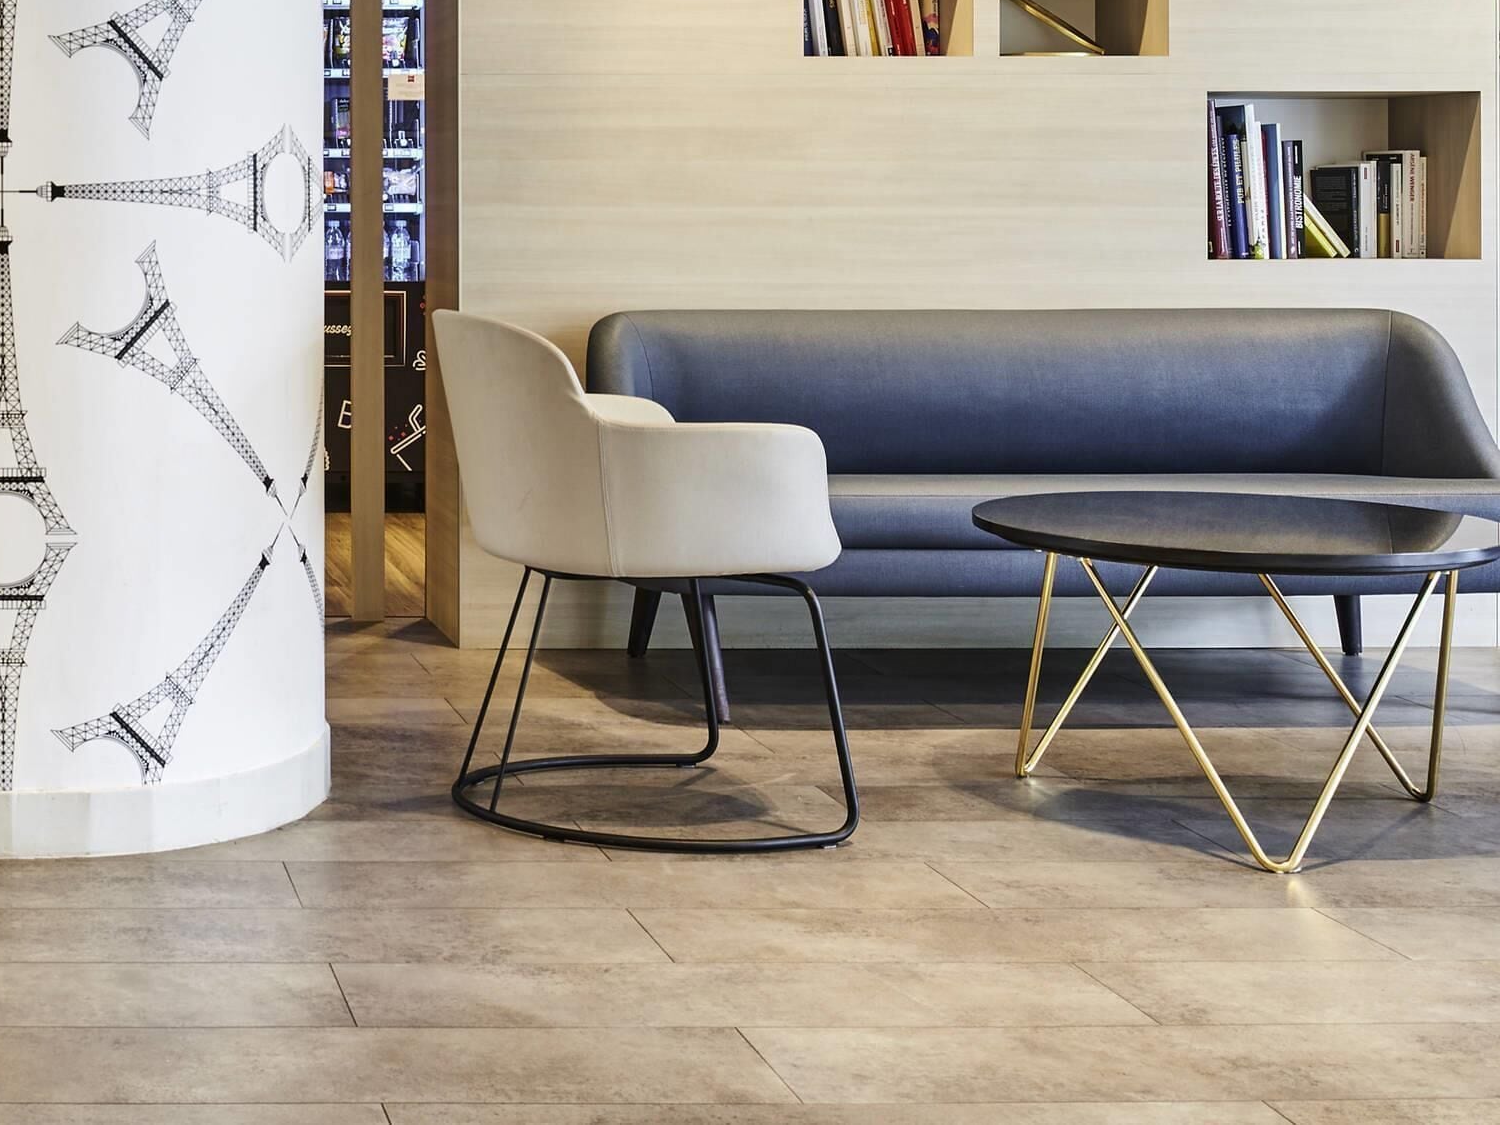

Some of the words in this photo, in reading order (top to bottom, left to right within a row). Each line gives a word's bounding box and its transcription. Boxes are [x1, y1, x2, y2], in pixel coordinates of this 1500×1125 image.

[1211, 146, 1220, 167] ÉPICES
[1233, 139, 1242, 172] PILULES
[1214, 179, 1222, 200] ROUTE
[1235, 174, 1243, 185] ET
[1236, 188, 1244, 204] PUB
[1293, 175, 1303, 229] BISTRONOMIE
